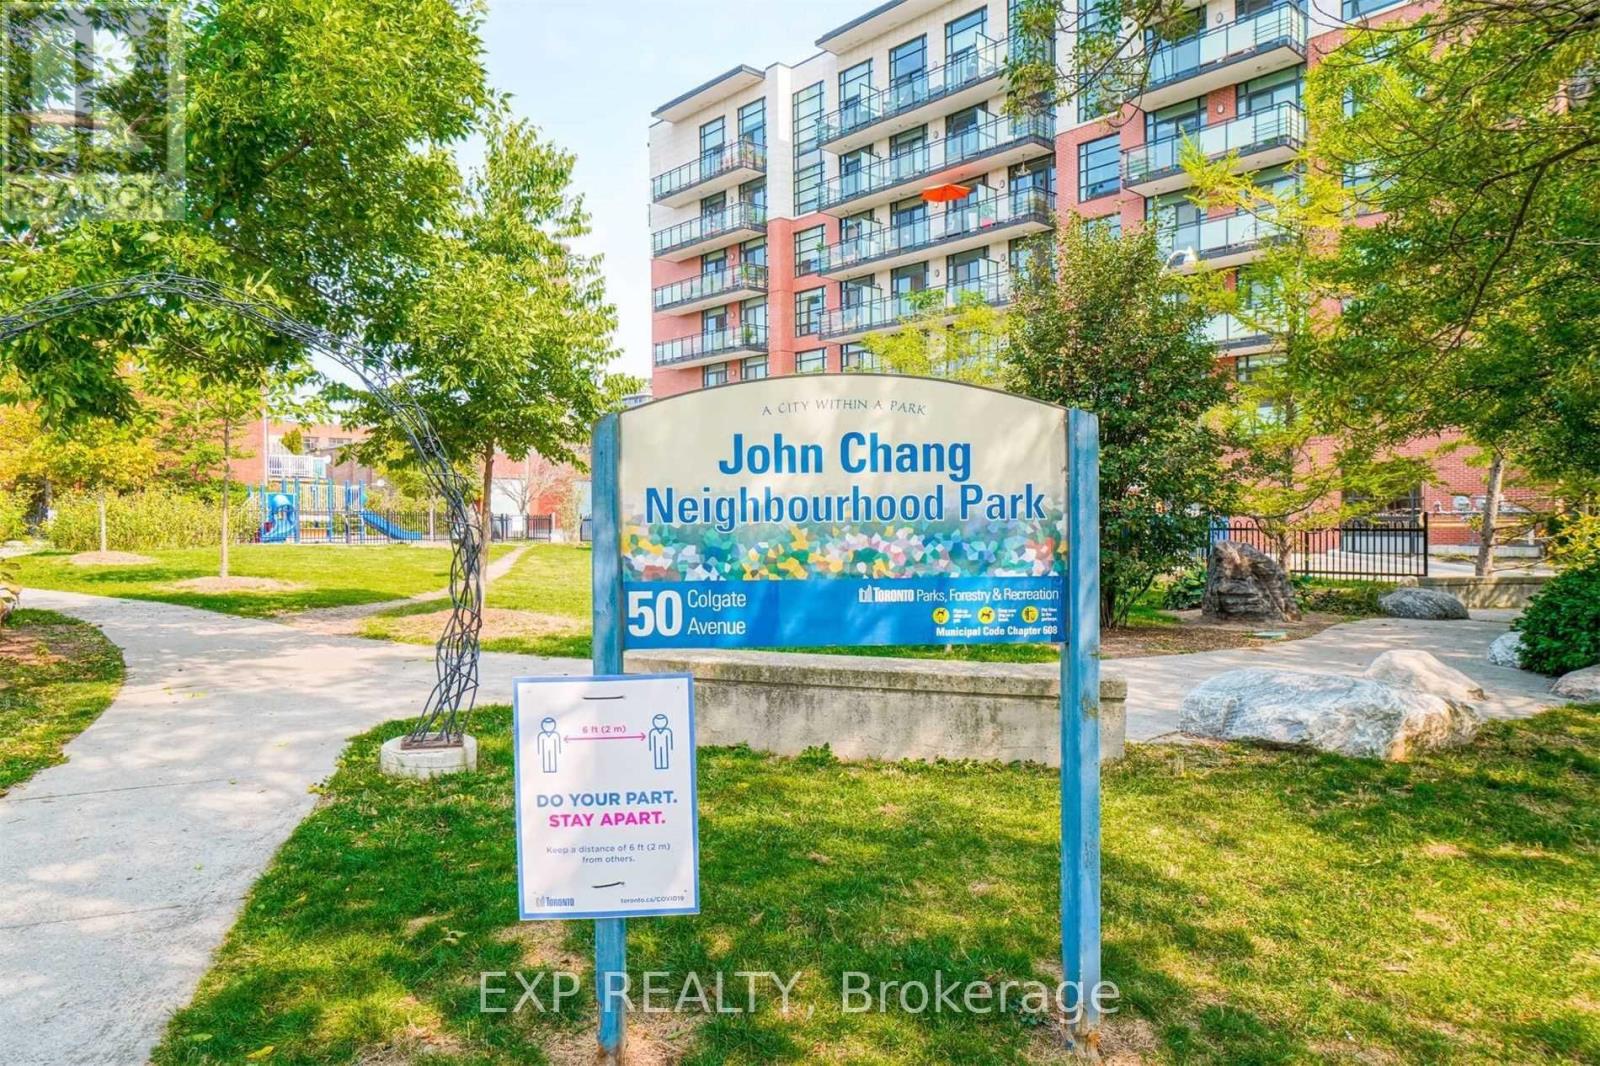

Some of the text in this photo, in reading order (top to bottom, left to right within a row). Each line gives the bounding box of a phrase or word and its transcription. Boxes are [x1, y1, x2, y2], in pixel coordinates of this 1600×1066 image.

[762, 399, 926, 416] A CITY WITHIN A PARK
[718, 431, 971, 482] John Chang
[645, 483, 1046, 532] Neighbourhood Park
[687, 589, 746, 611] Colgate
[916, 589, 948, 603] Parks,
[950, 589, 991, 603] Forestry
[993, 589, 1002, 601] &
[1004, 587, 1059, 600] Recreation
[627, 590, 683, 637] 50
[687, 617, 746, 635] Avenue
[935, 627, 981, 638] Municipal
[983, 626, 1005, 637] Code
[1007, 625, 1041, 637] Chapter
[582, 726, 588, 734] 6
[602, 726, 611, 734] (2
[614, 725, 627, 733] m)
[537, 791, 678, 808] DO YOUR PART.
[549, 811, 666, 827] STAY APART.
[546, 847, 569, 856] Keep
[579, 846, 616, 854] distance
[618, 844, 627, 852] of
[637, 843, 644, 851] ft
[647, 843, 656, 852] (2
[658, 842, 671, 851] m)
[582, 854, 635, 864] from others.
